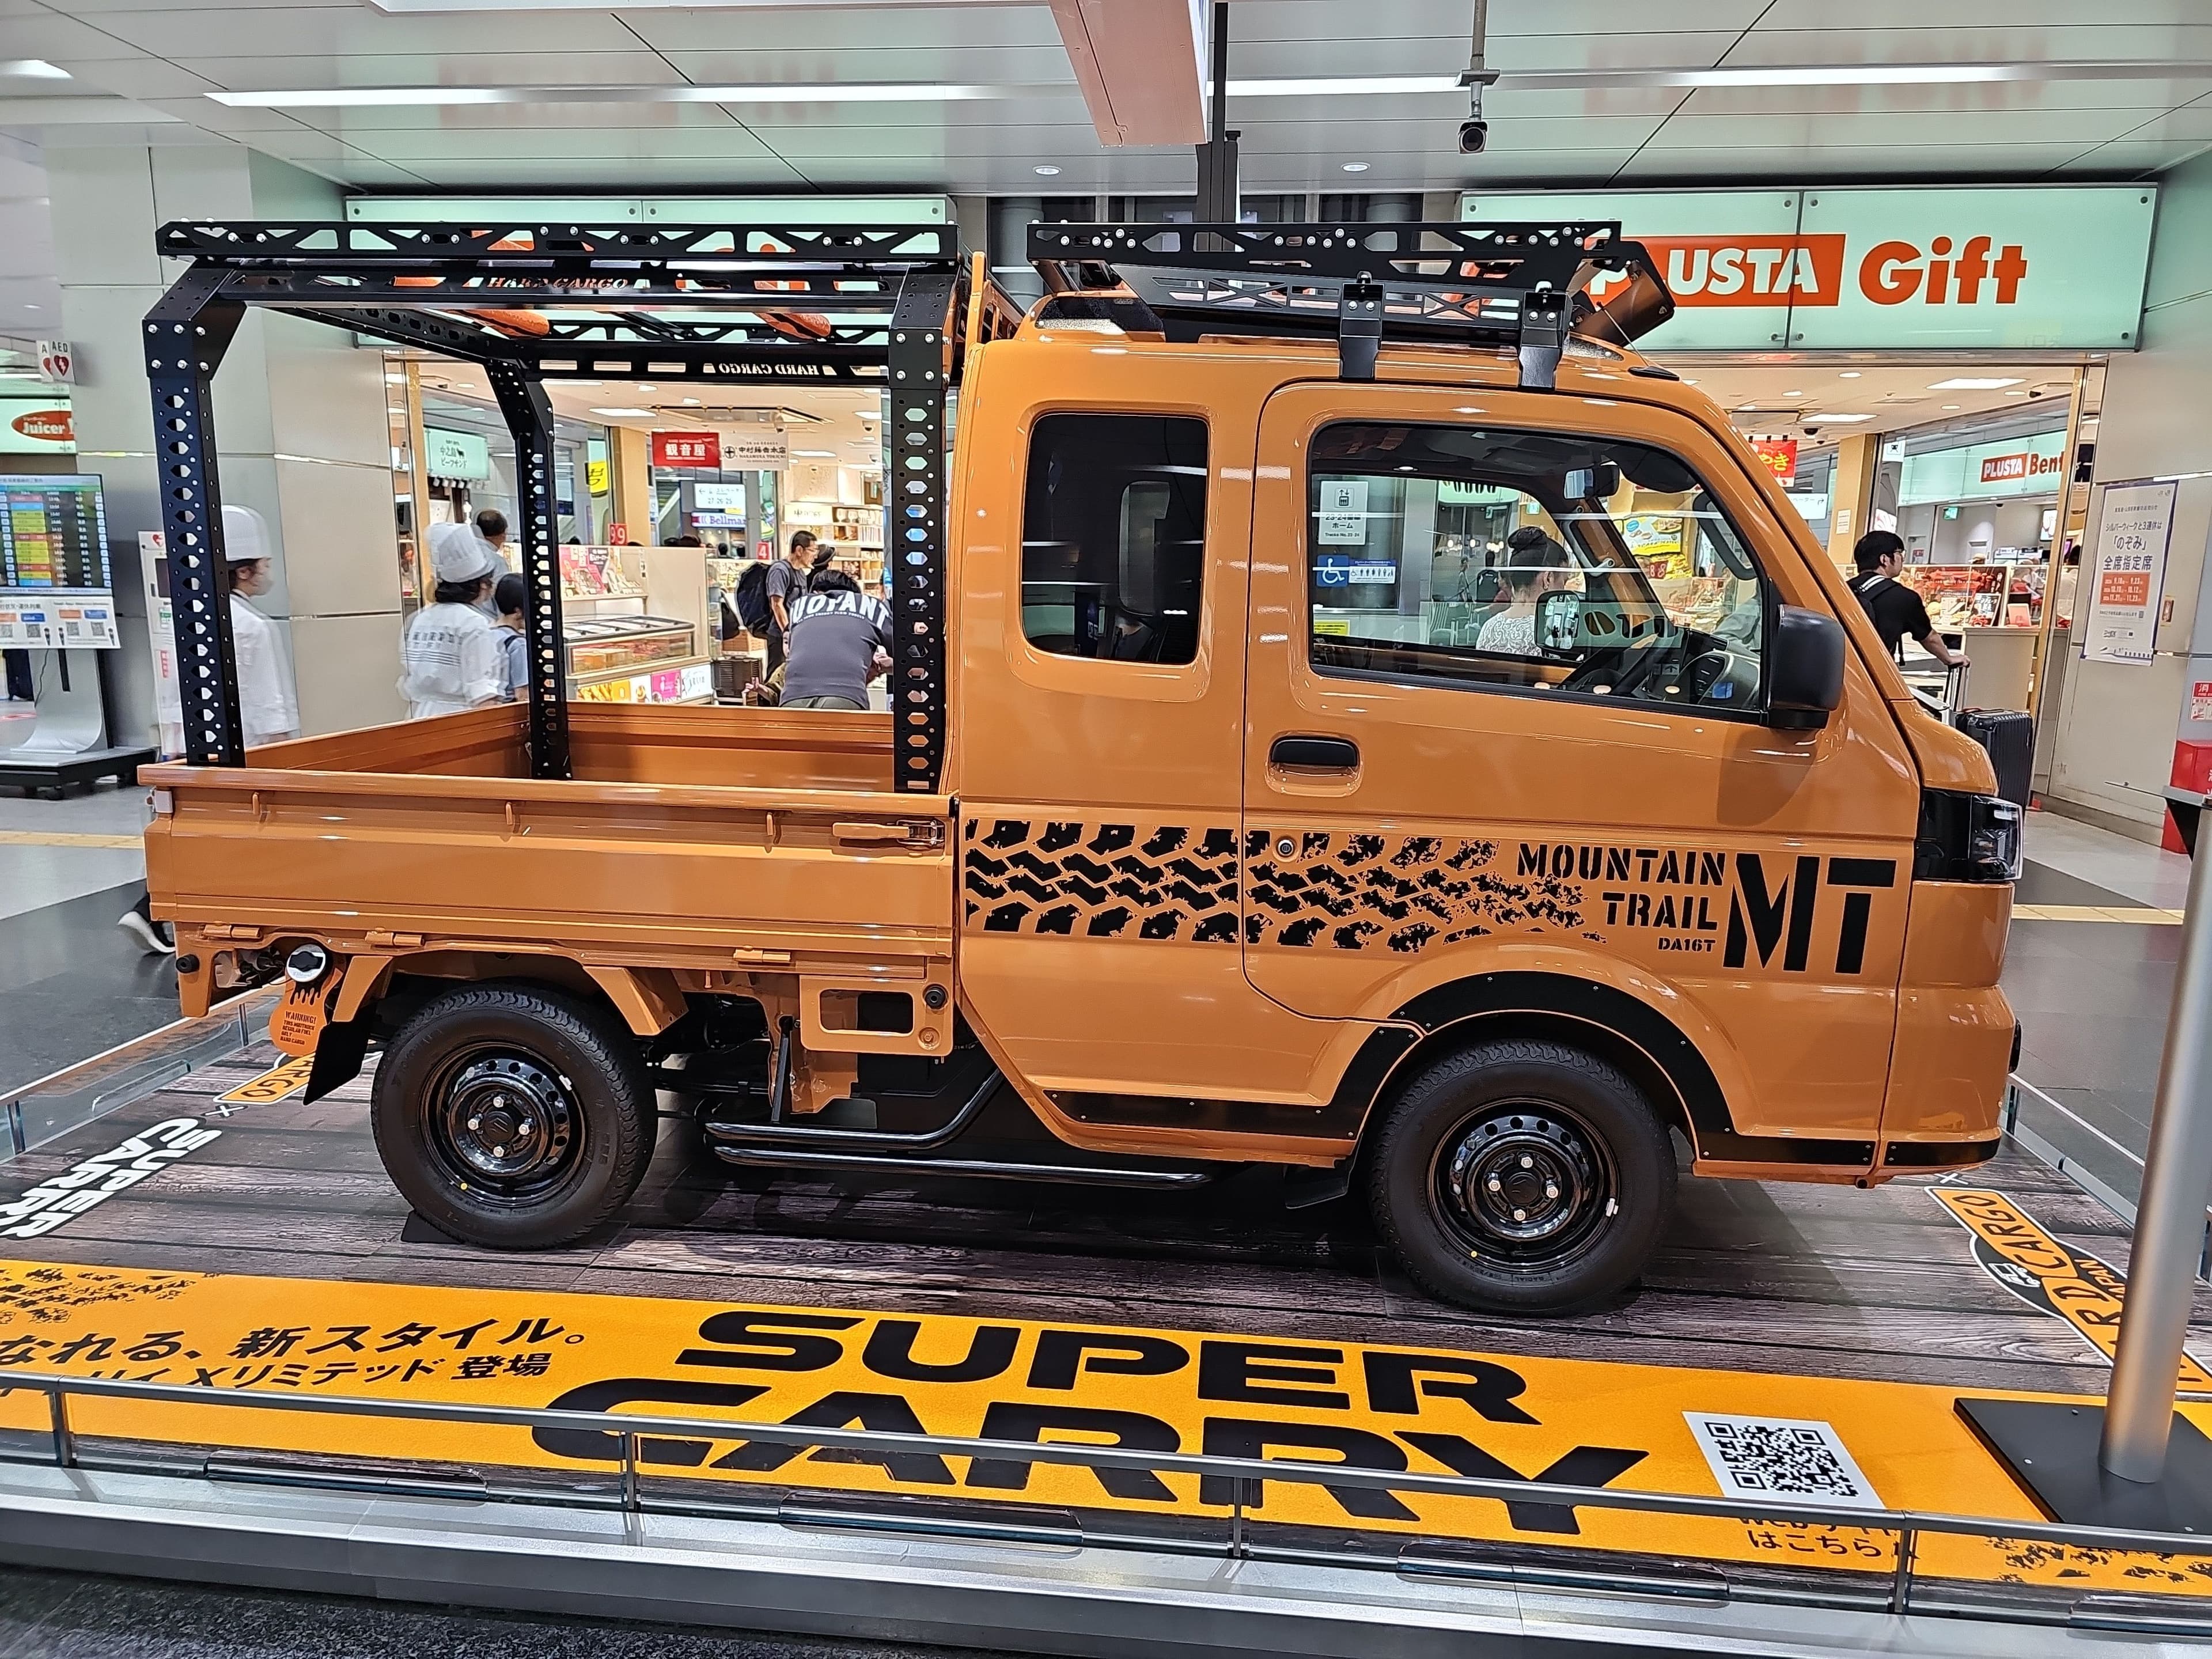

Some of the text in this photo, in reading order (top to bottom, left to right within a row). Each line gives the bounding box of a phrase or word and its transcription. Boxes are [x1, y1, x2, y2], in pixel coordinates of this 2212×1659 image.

[487, 277, 628, 289] HARD CARGO
[1590, 236, 2028, 305] PUSTA Gift
[52, 340, 68, 353] AED
[22, 421, 66, 434] Juicer
[665, 443, 706, 456] 観音屋
[1983, 457, 2023, 479] PLUSTA
[2105, 521, 2162, 532] シルバーウィークと3連休は
[758, 545, 768, 559] 4
[2113, 535, 2146, 551] 「のぞみ」
[2103, 555, 2153, 571] 全席指定席
[790, 590, 890, 631] UOYANT
[1517, 842, 1726, 887] MOUNTAIN
[1602, 891, 1719, 931] TRAIL
[1722, 852, 1897, 975] MT
[1658, 937, 1716, 952] DA16T
[286, 1010, 317, 1024] WARNING!
[0, 1129, 223, 1238] SUPER
[1952, 1194, 2068, 1270] CARGO
[450, 1353, 552, 1381] 登場
[676, 1310, 1540, 1426] SUPER
[532, 1377, 1649, 1535] CARRY
[1747, 1529, 1882, 1557] はこちら
